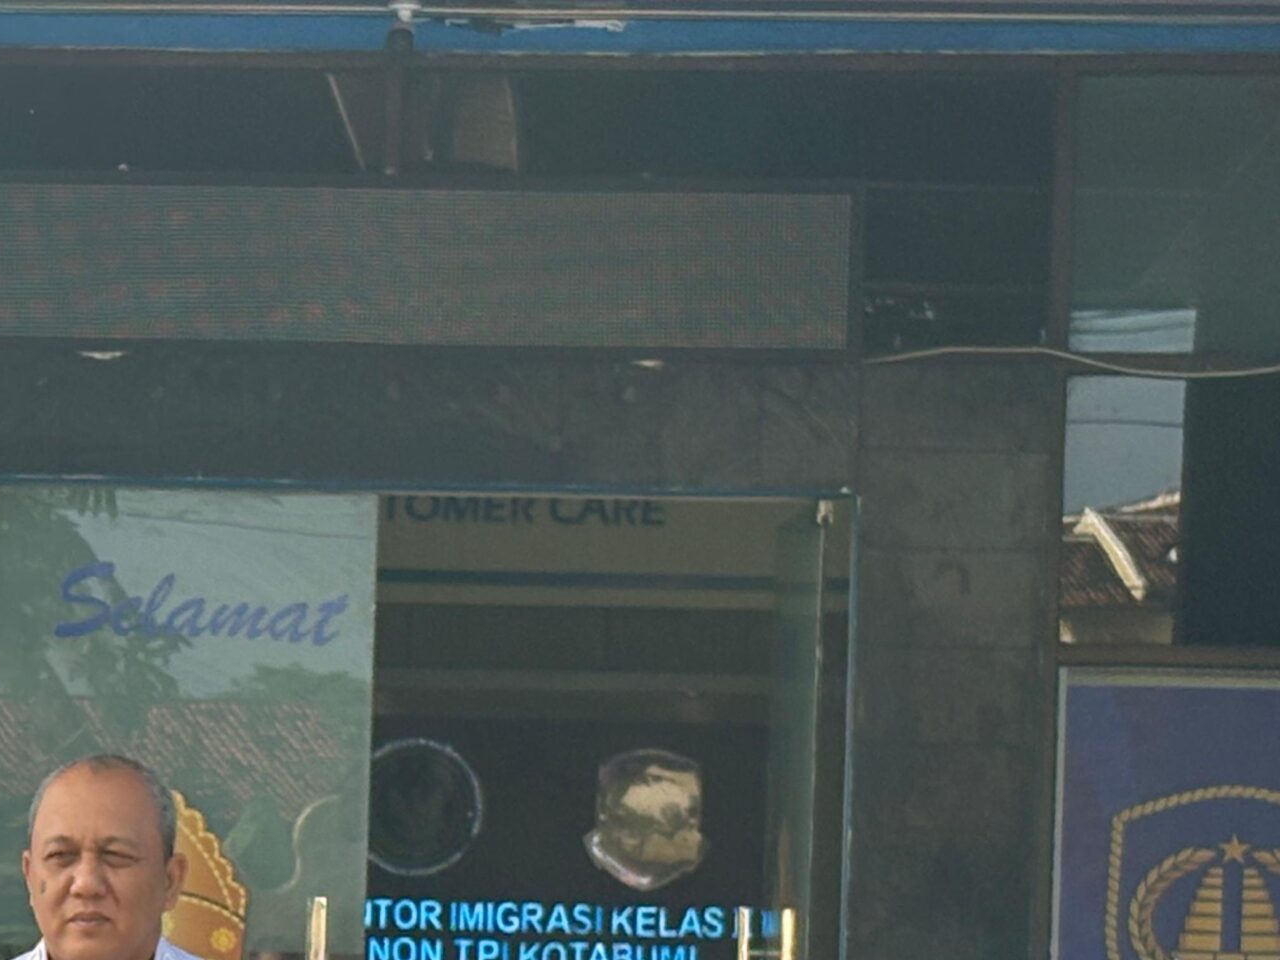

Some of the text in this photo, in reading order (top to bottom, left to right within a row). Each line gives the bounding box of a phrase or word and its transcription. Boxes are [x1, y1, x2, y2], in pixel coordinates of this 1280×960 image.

[549, 497, 666, 526] CARE
[54, 561, 349, 646] Selamat
[450, 902, 602, 934] IMIGRASI
[611, 907, 723, 938] KELAS
